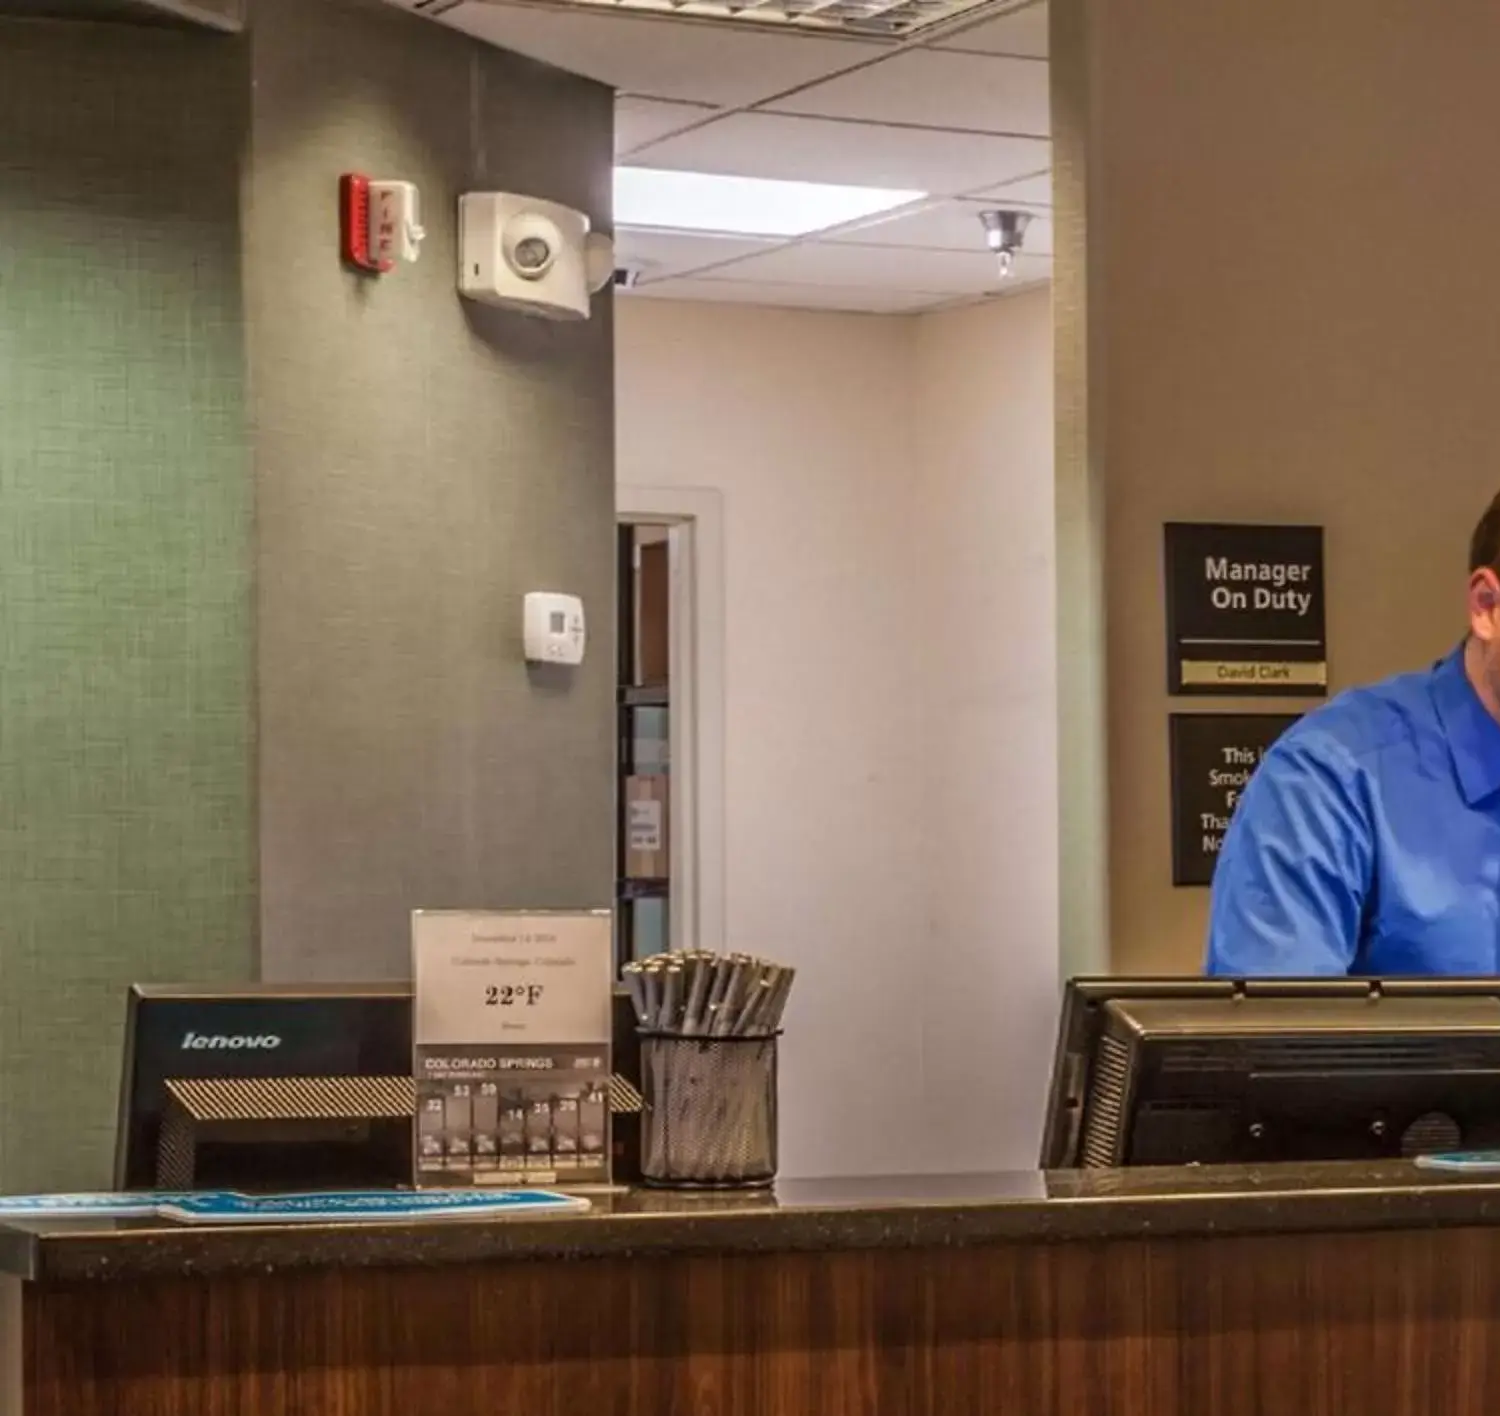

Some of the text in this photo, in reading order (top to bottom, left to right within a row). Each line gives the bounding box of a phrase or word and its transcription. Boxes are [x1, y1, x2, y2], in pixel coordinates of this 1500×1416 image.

[1204, 557, 1312, 587] Manager
[1211, 587, 1312, 616] On Duty
[1217, 664, 1290, 680] David Clark
[1222, 747, 1255, 765] This
[485, 984, 544, 1006] 22°F
[181, 1031, 282, 1050] lenovo
[425, 1057, 553, 1070] COLORADO SPRINGS
